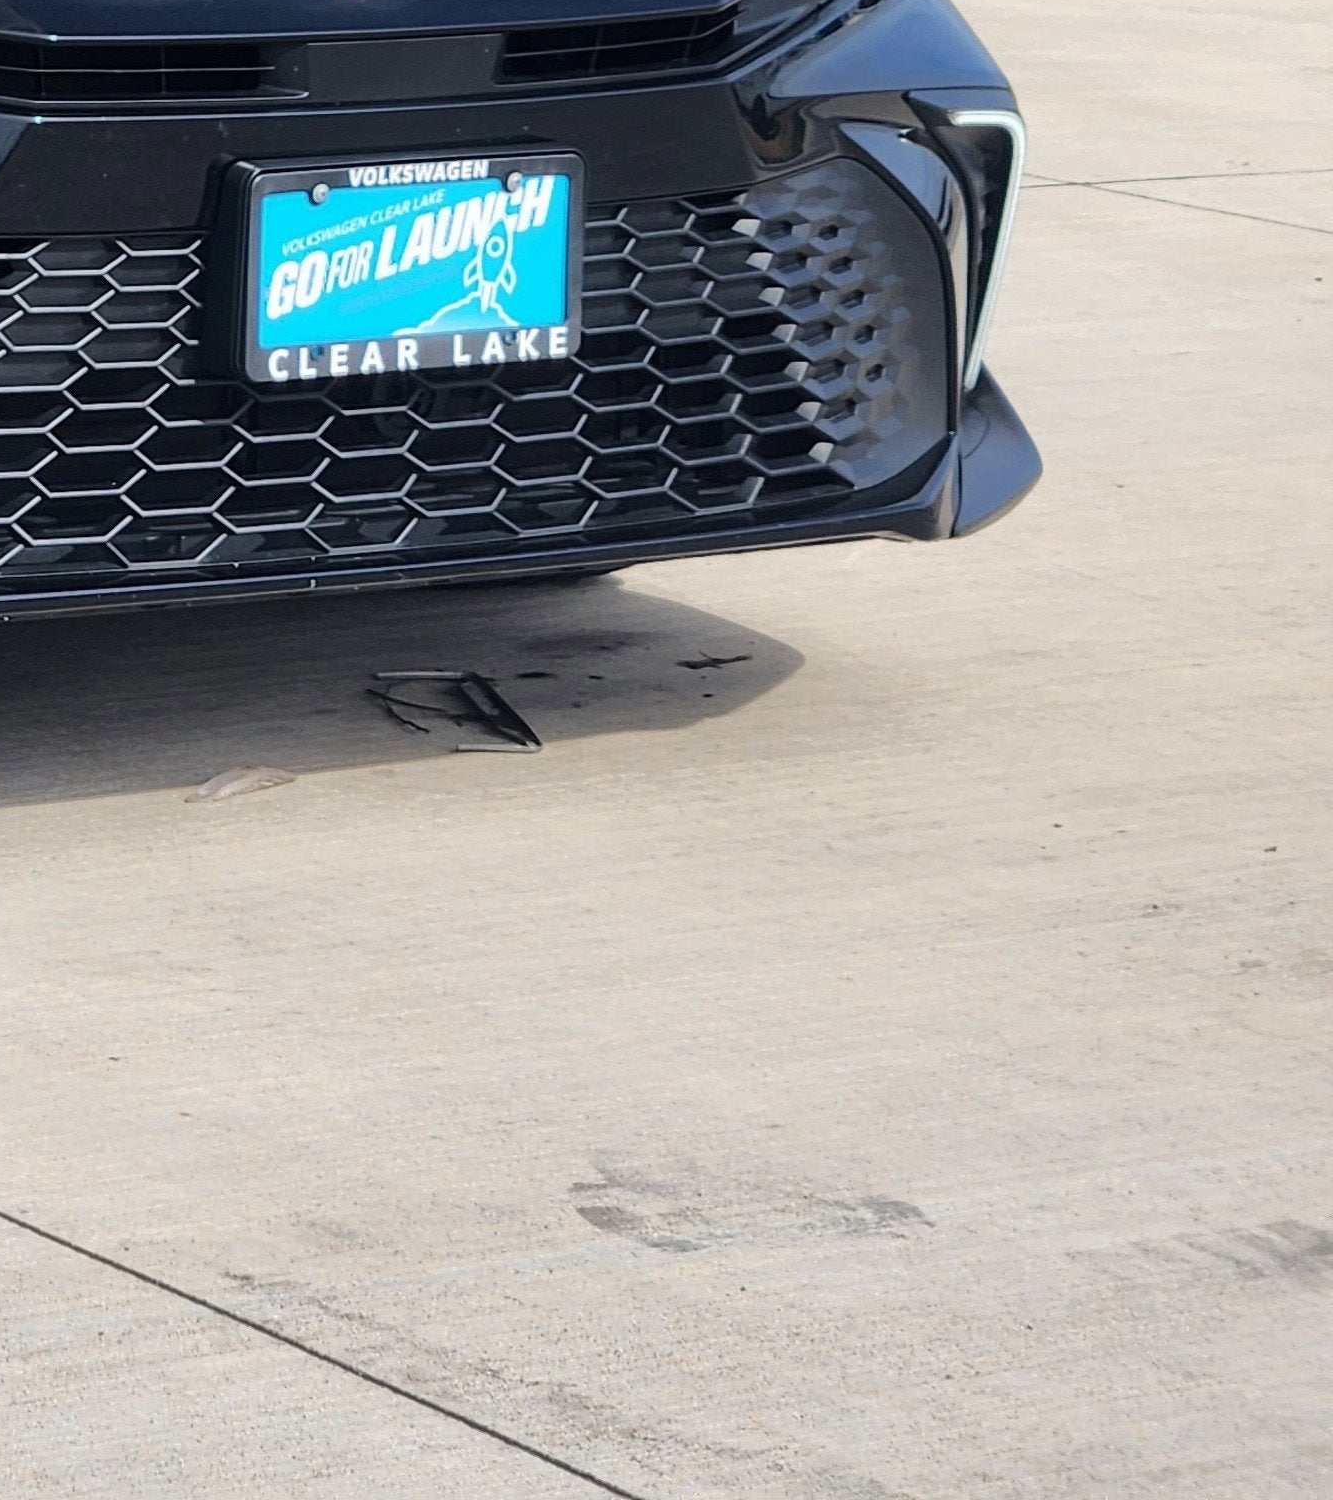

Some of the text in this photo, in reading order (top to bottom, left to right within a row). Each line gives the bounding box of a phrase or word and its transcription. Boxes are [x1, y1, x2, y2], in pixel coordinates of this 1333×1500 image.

[348, 160, 489, 187] VOLKSWAGEN
[267, 175, 554, 320] GO FOR LAUNCH
[282, 188, 446, 256] VOLKSWAGEN CLEAR LAKE
[268, 326, 569, 382] CLEAR LAKE
